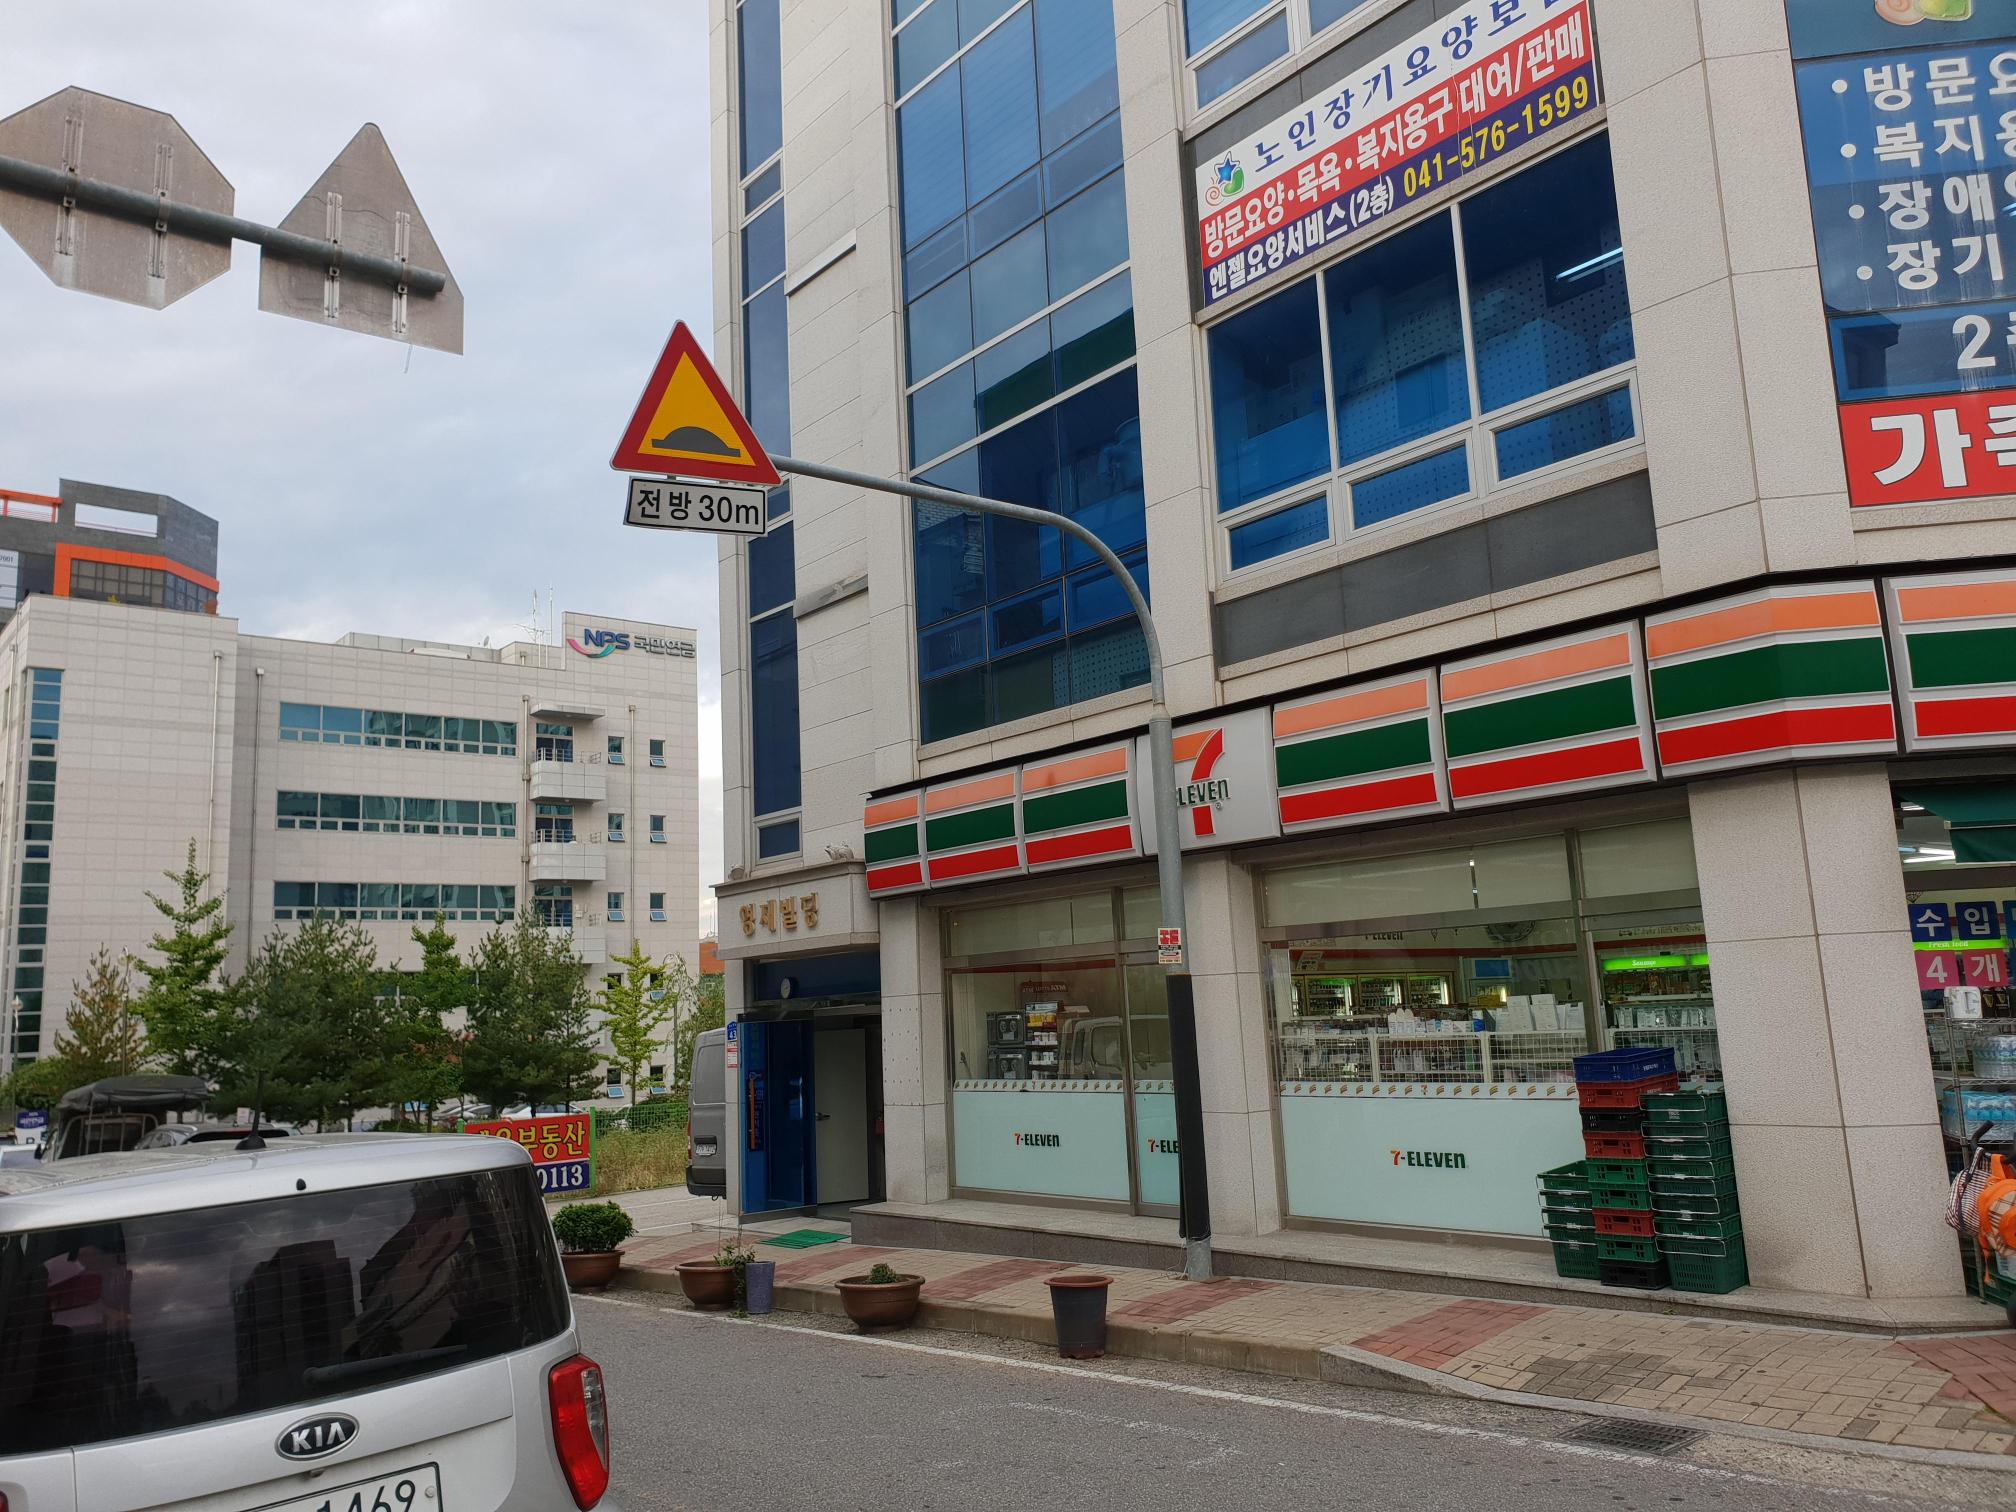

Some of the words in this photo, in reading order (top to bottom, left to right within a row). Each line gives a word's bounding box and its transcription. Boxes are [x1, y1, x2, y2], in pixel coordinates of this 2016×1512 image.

[1254, 0, 1558, 173] 노인장기요양보
[1403, 76, 1589, 198] 041-576-1599
[1878, 170, 2016, 231] 장애
[584, 628, 631, 651] NPS
[291, 1421, 347, 1453] KIA
